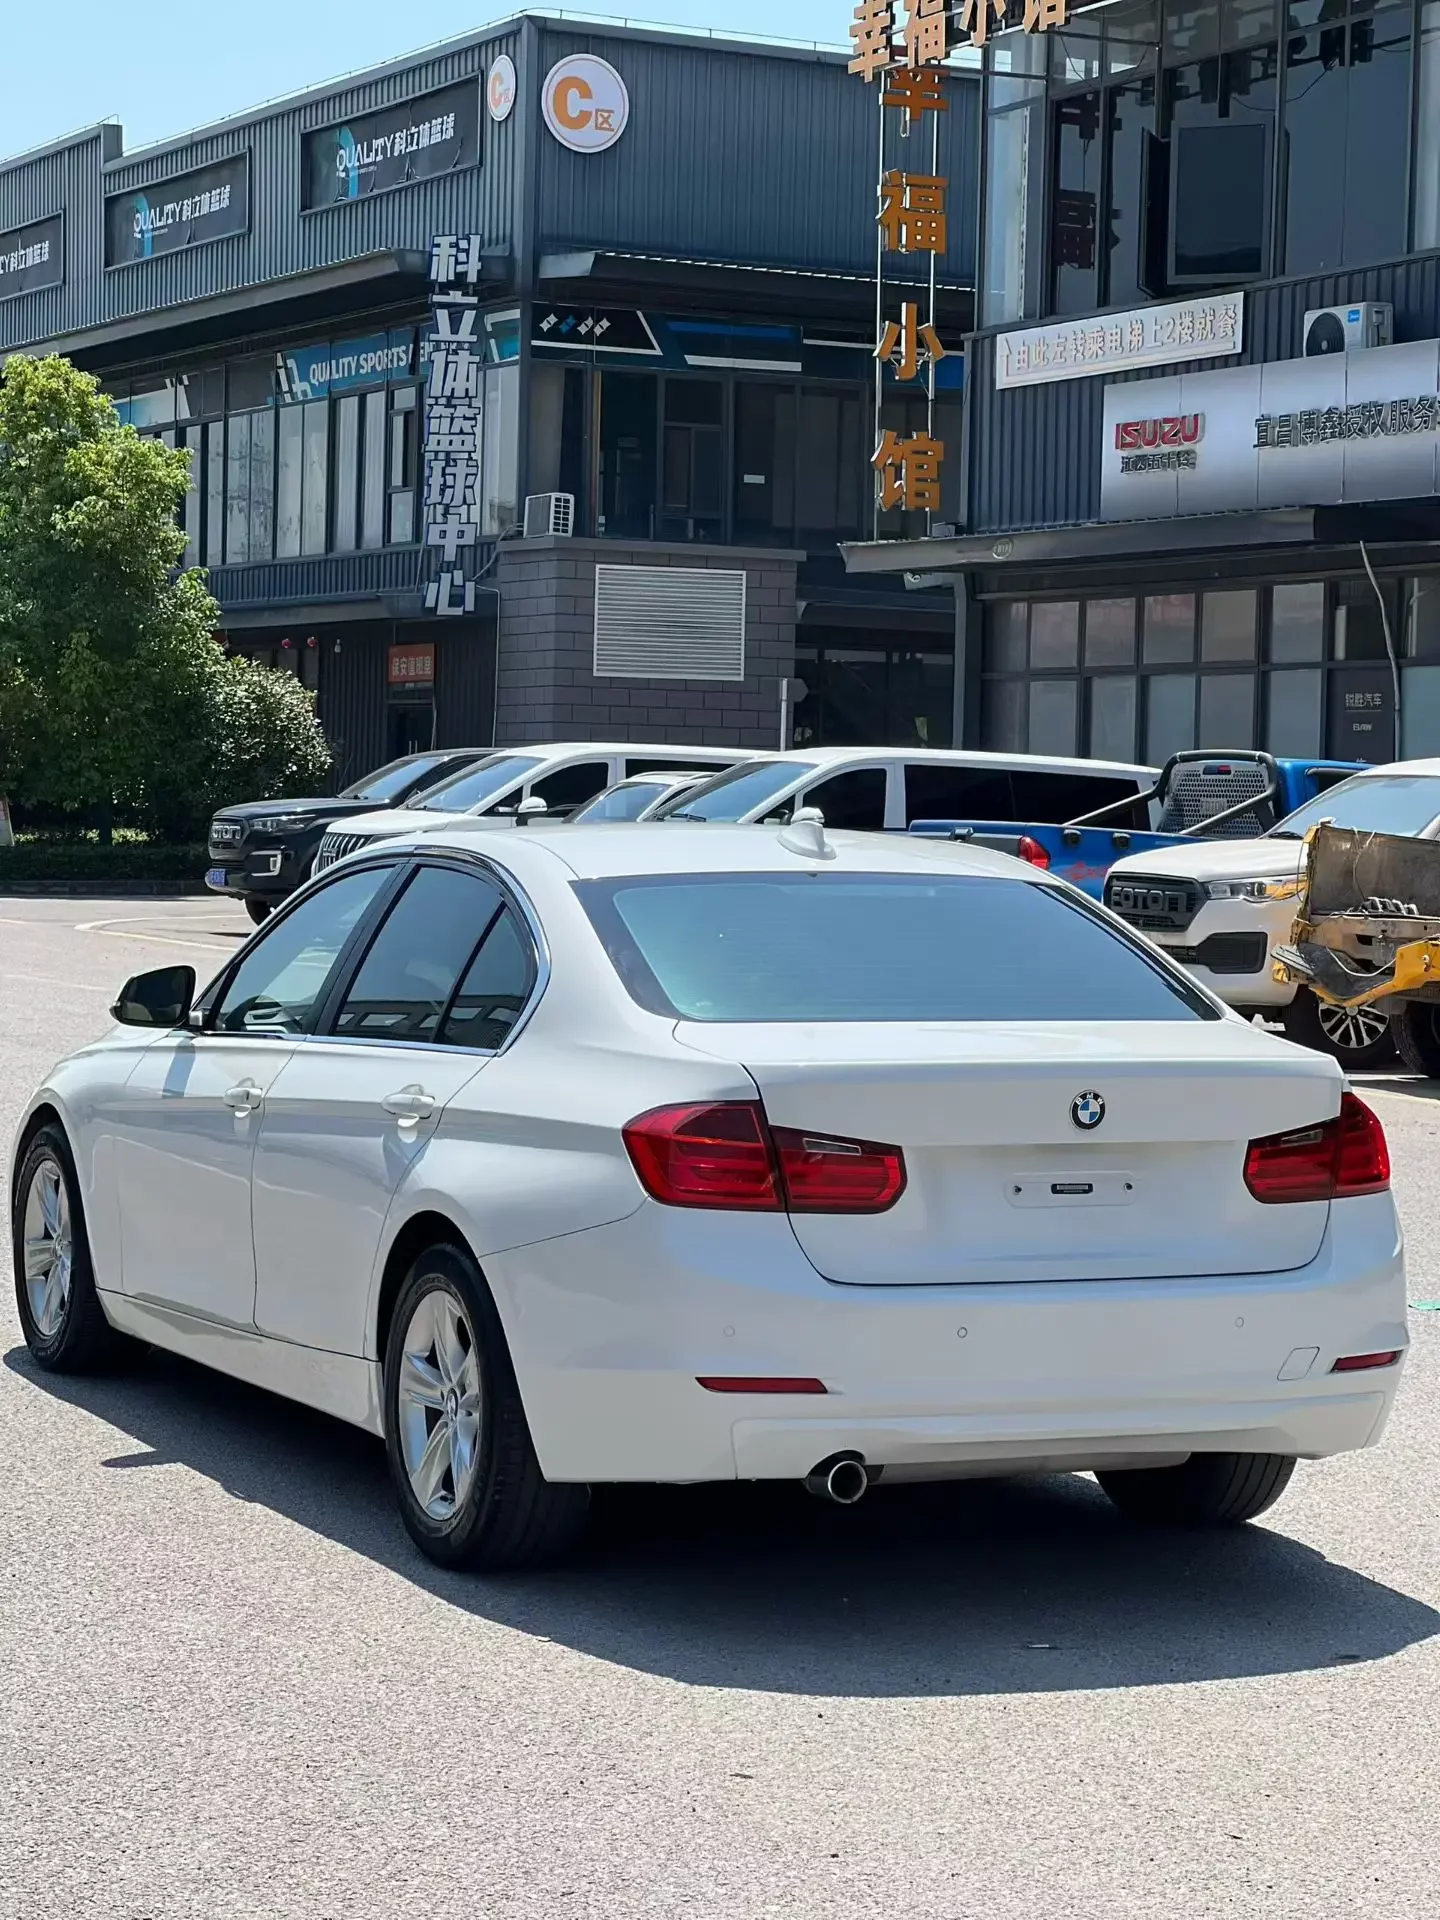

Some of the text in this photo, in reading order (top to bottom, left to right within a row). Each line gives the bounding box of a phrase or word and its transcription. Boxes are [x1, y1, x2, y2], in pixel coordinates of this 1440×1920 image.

[553, 75, 615, 132] C区
[308, 355, 359, 386] QUALITY
[359, 344, 407, 375] SPORTS
[425, 234, 482, 616] 科立体篮球中心
[1115, 413, 1203, 450] ISUZU
[1253, 396, 1440, 449] 宜昌博鑫授权服务
